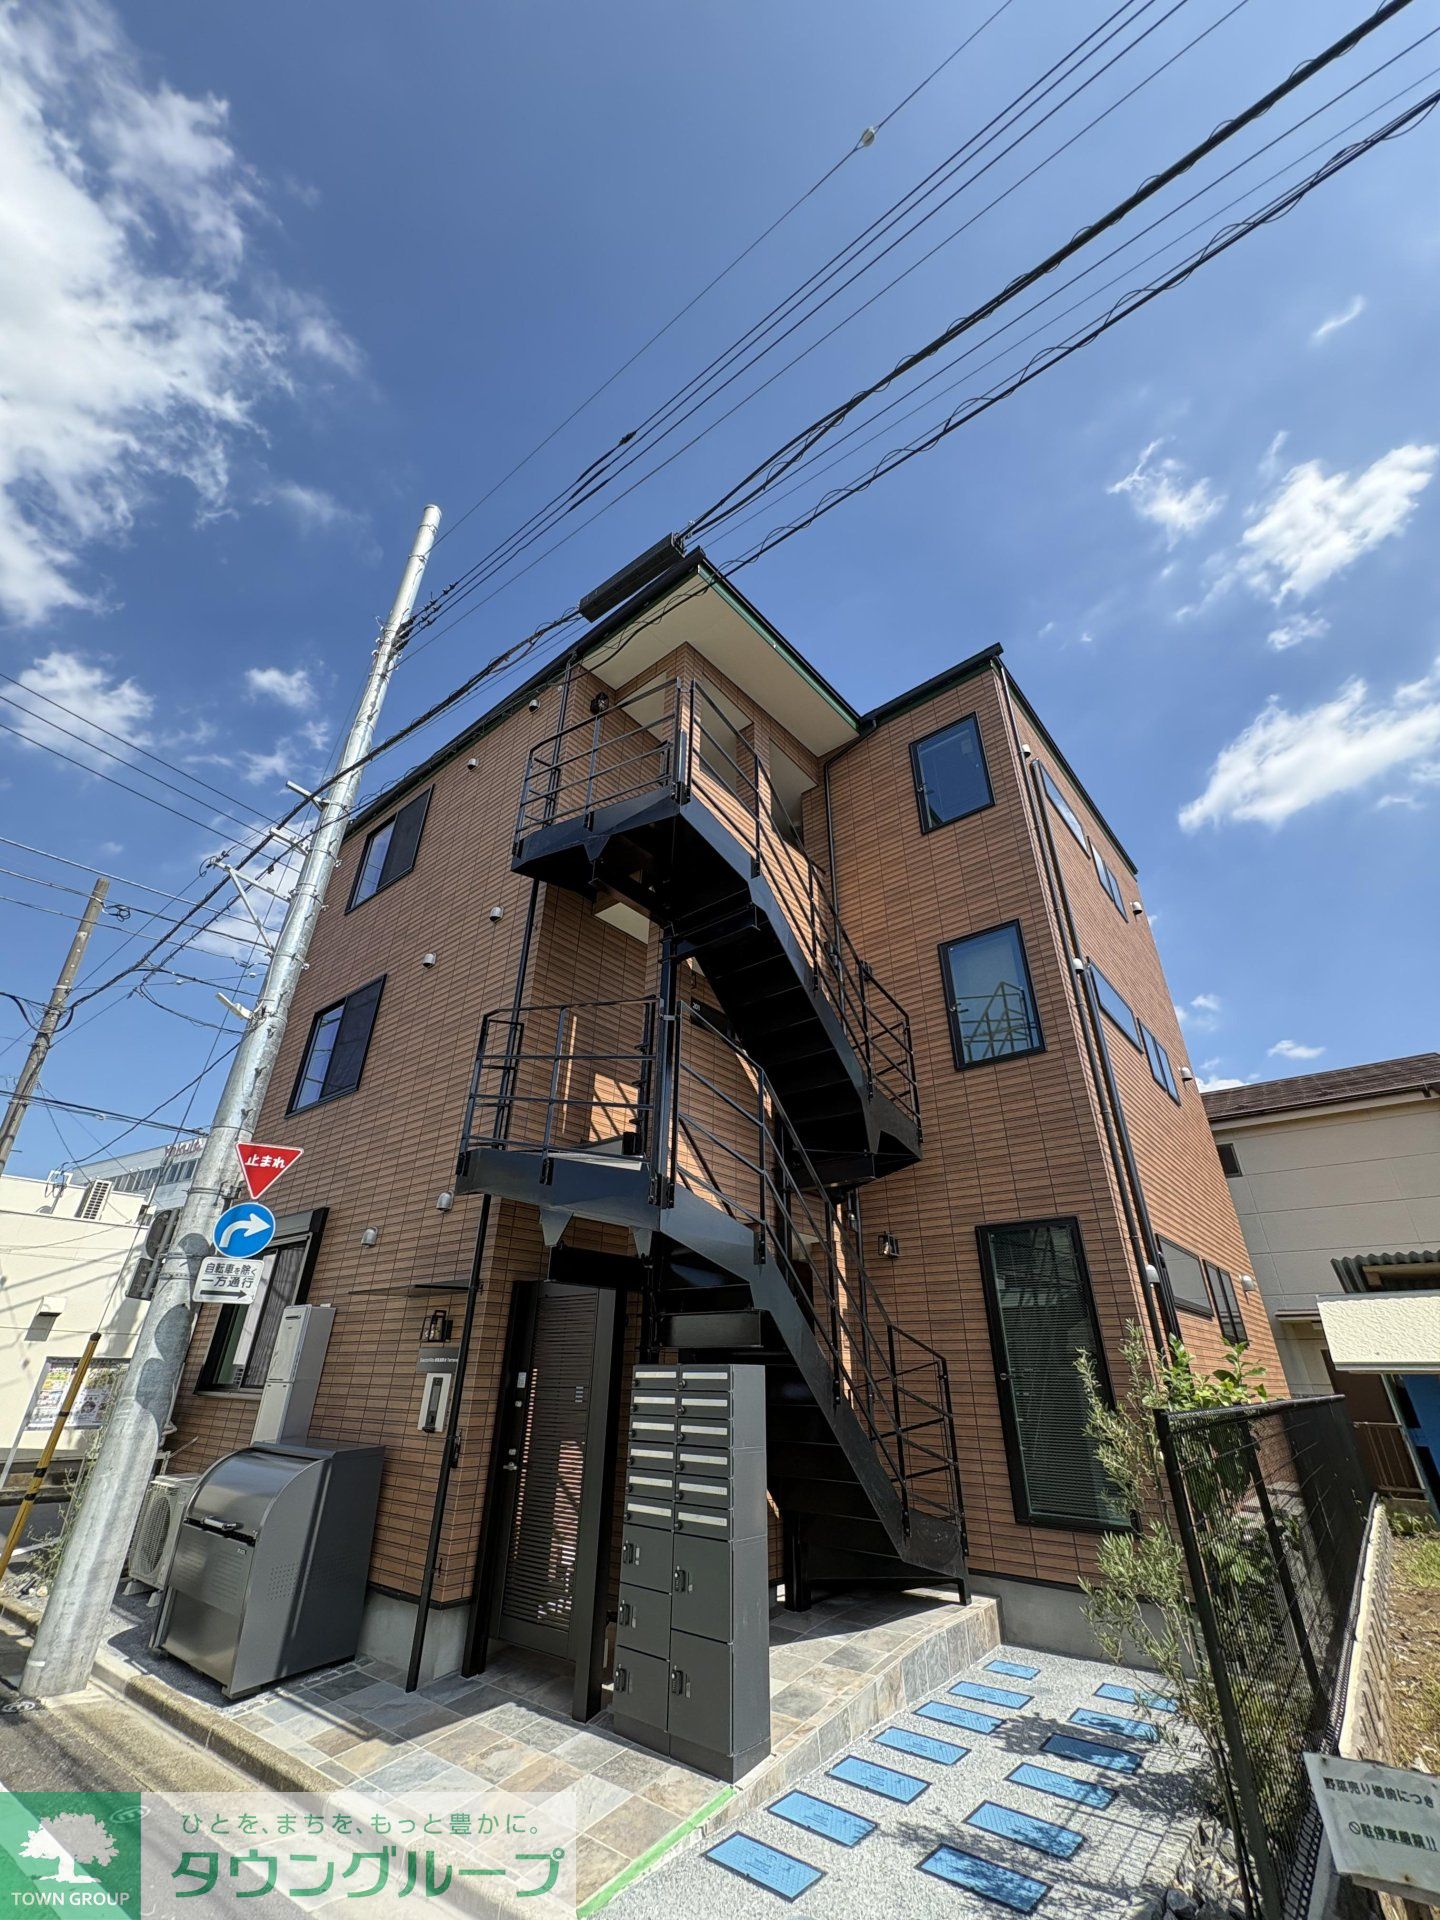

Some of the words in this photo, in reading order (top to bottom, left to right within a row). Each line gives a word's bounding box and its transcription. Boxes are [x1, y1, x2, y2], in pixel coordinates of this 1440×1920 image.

[245, 1154, 286, 1170] 止まれ
[205, 1262, 257, 1276] 自転車を除く
[201, 1276, 254, 1288] 一方通行
[1323, 1777, 1434, 1808] 野菜売り場前につき
